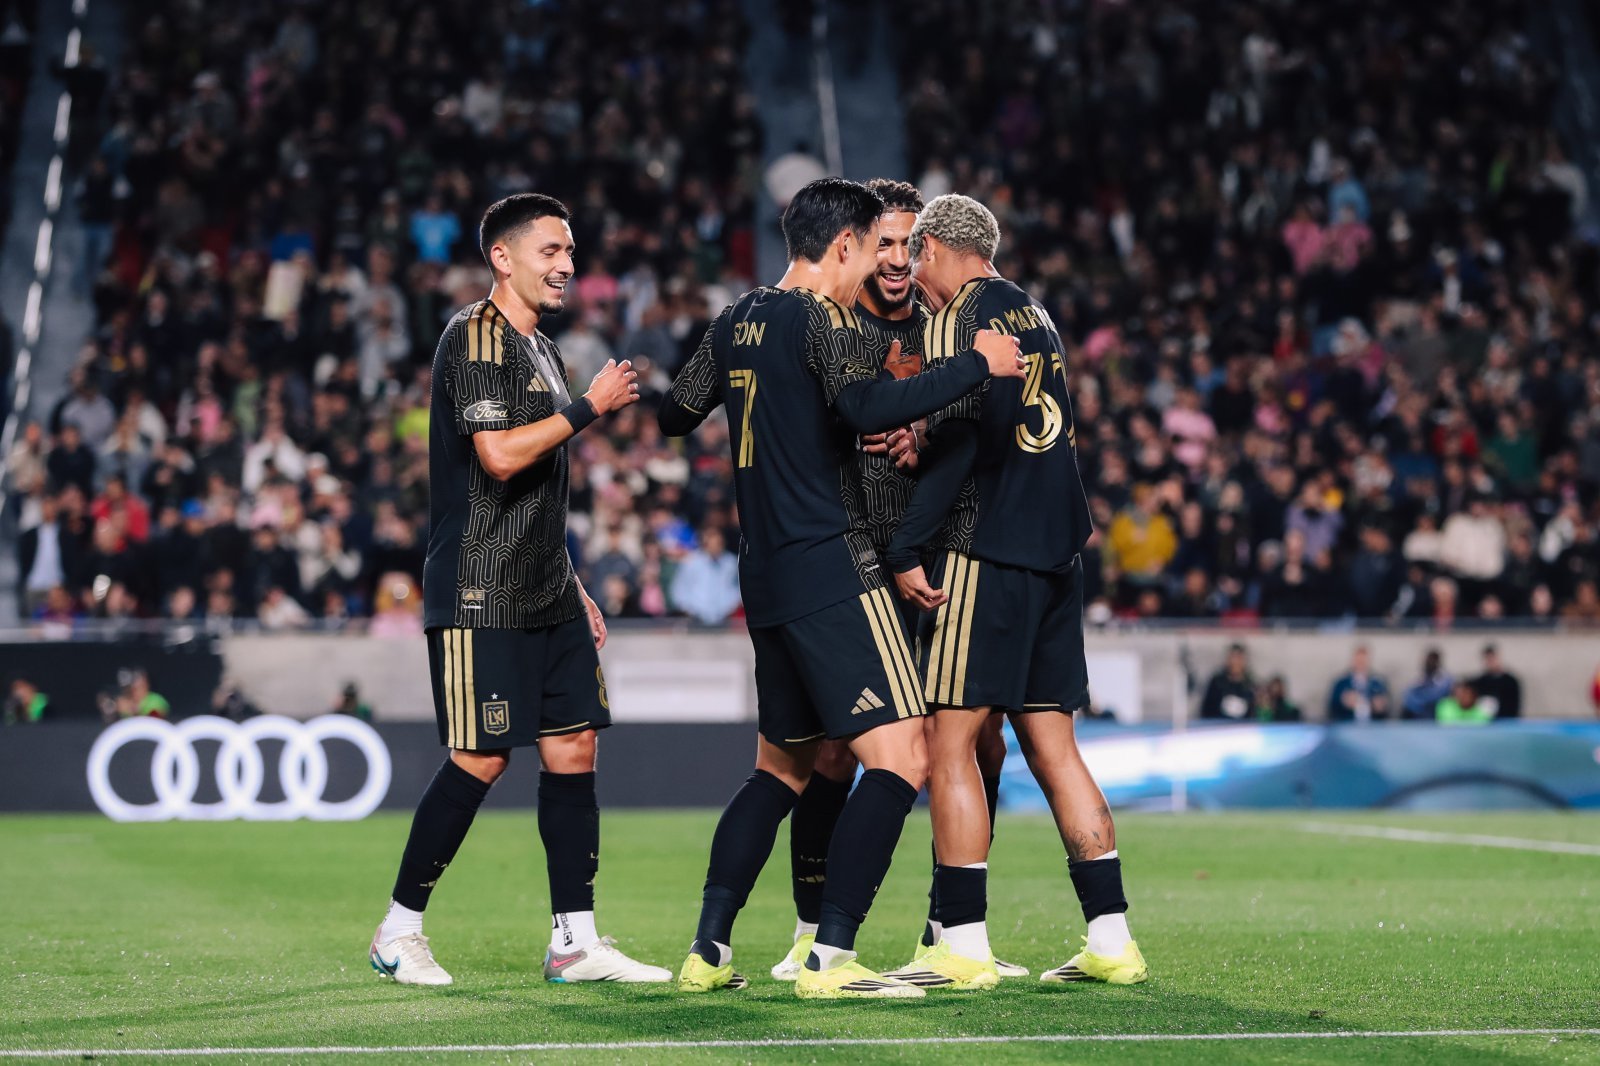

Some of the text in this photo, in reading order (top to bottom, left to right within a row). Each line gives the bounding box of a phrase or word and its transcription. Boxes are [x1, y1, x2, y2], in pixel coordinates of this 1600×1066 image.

[733, 320, 766, 347] SON
[845, 362, 876, 376] Ford
[474, 403, 509, 419] Ford
[729, 369, 757, 469] 7
